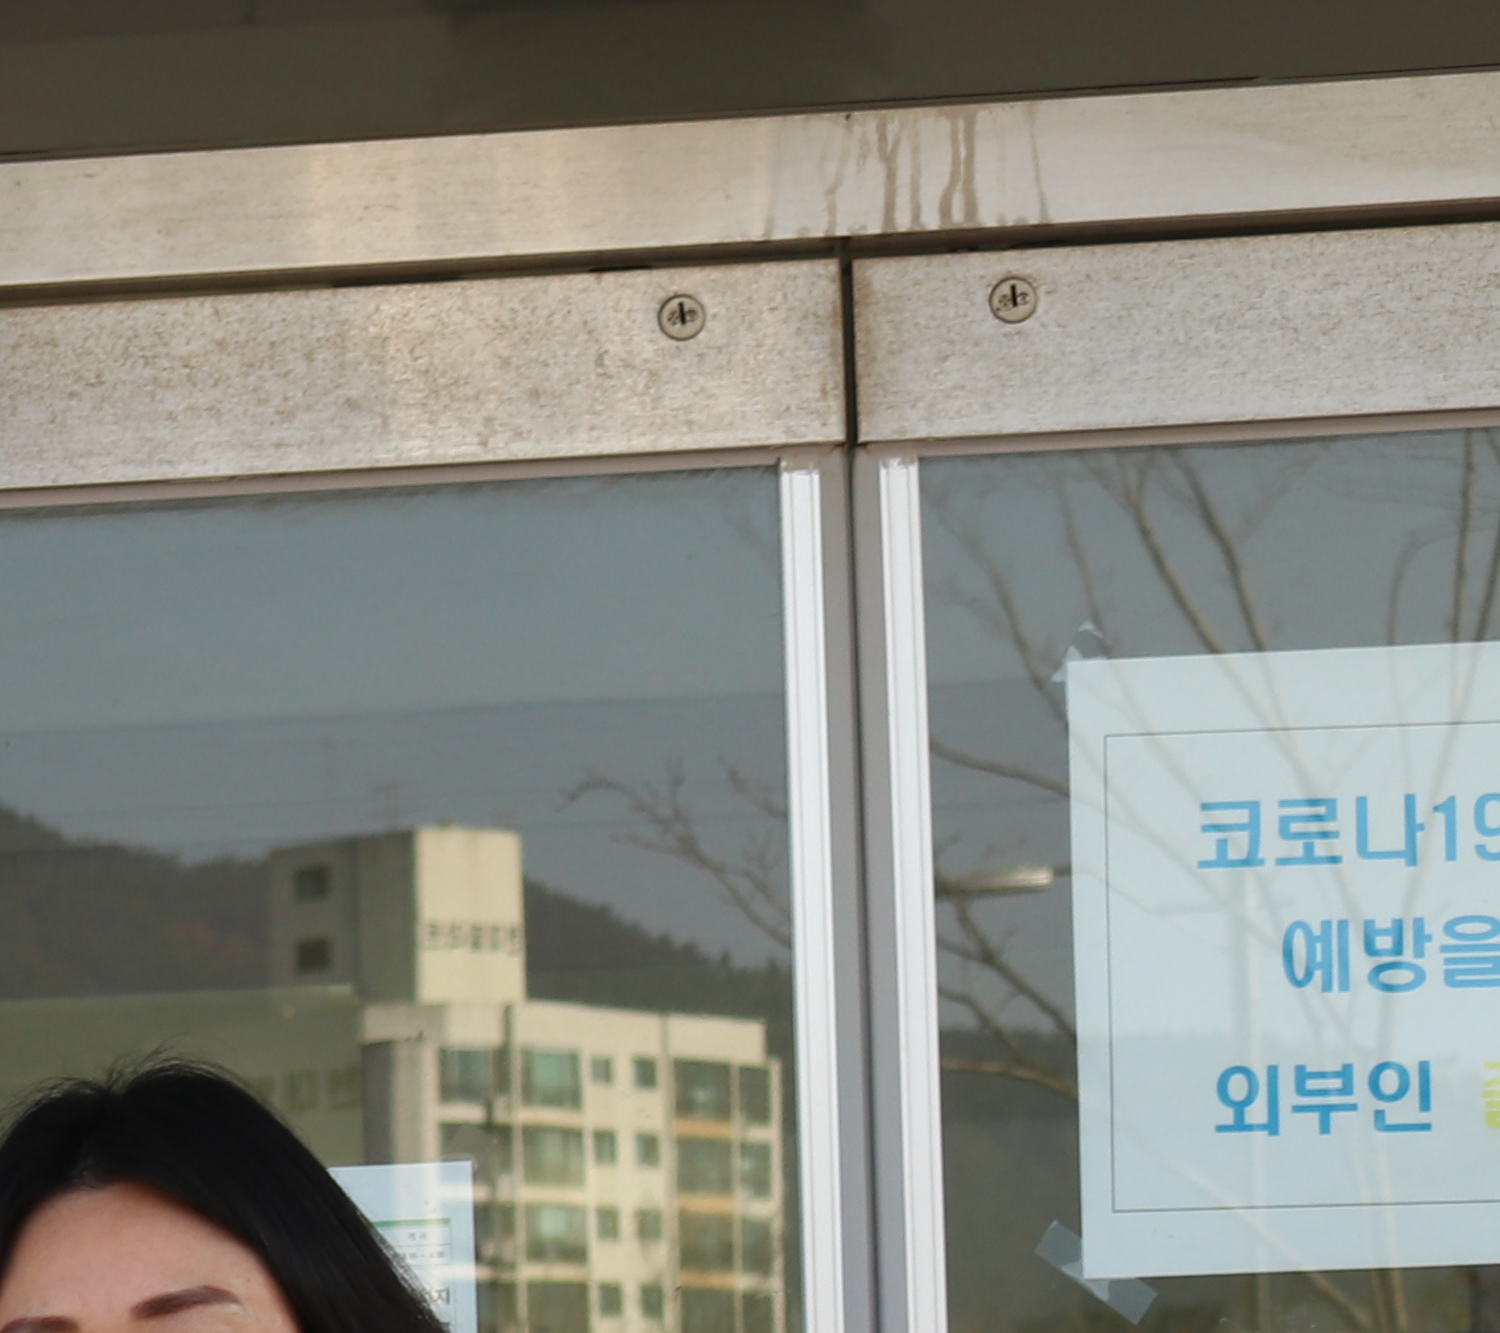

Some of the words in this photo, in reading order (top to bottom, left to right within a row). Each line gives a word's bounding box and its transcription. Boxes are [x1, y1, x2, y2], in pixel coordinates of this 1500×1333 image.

[1196, 792, 1499, 870] 코로나19
[1281, 913, 1499, 995] 예방을
[1214, 1060, 1433, 1137] 외부인
